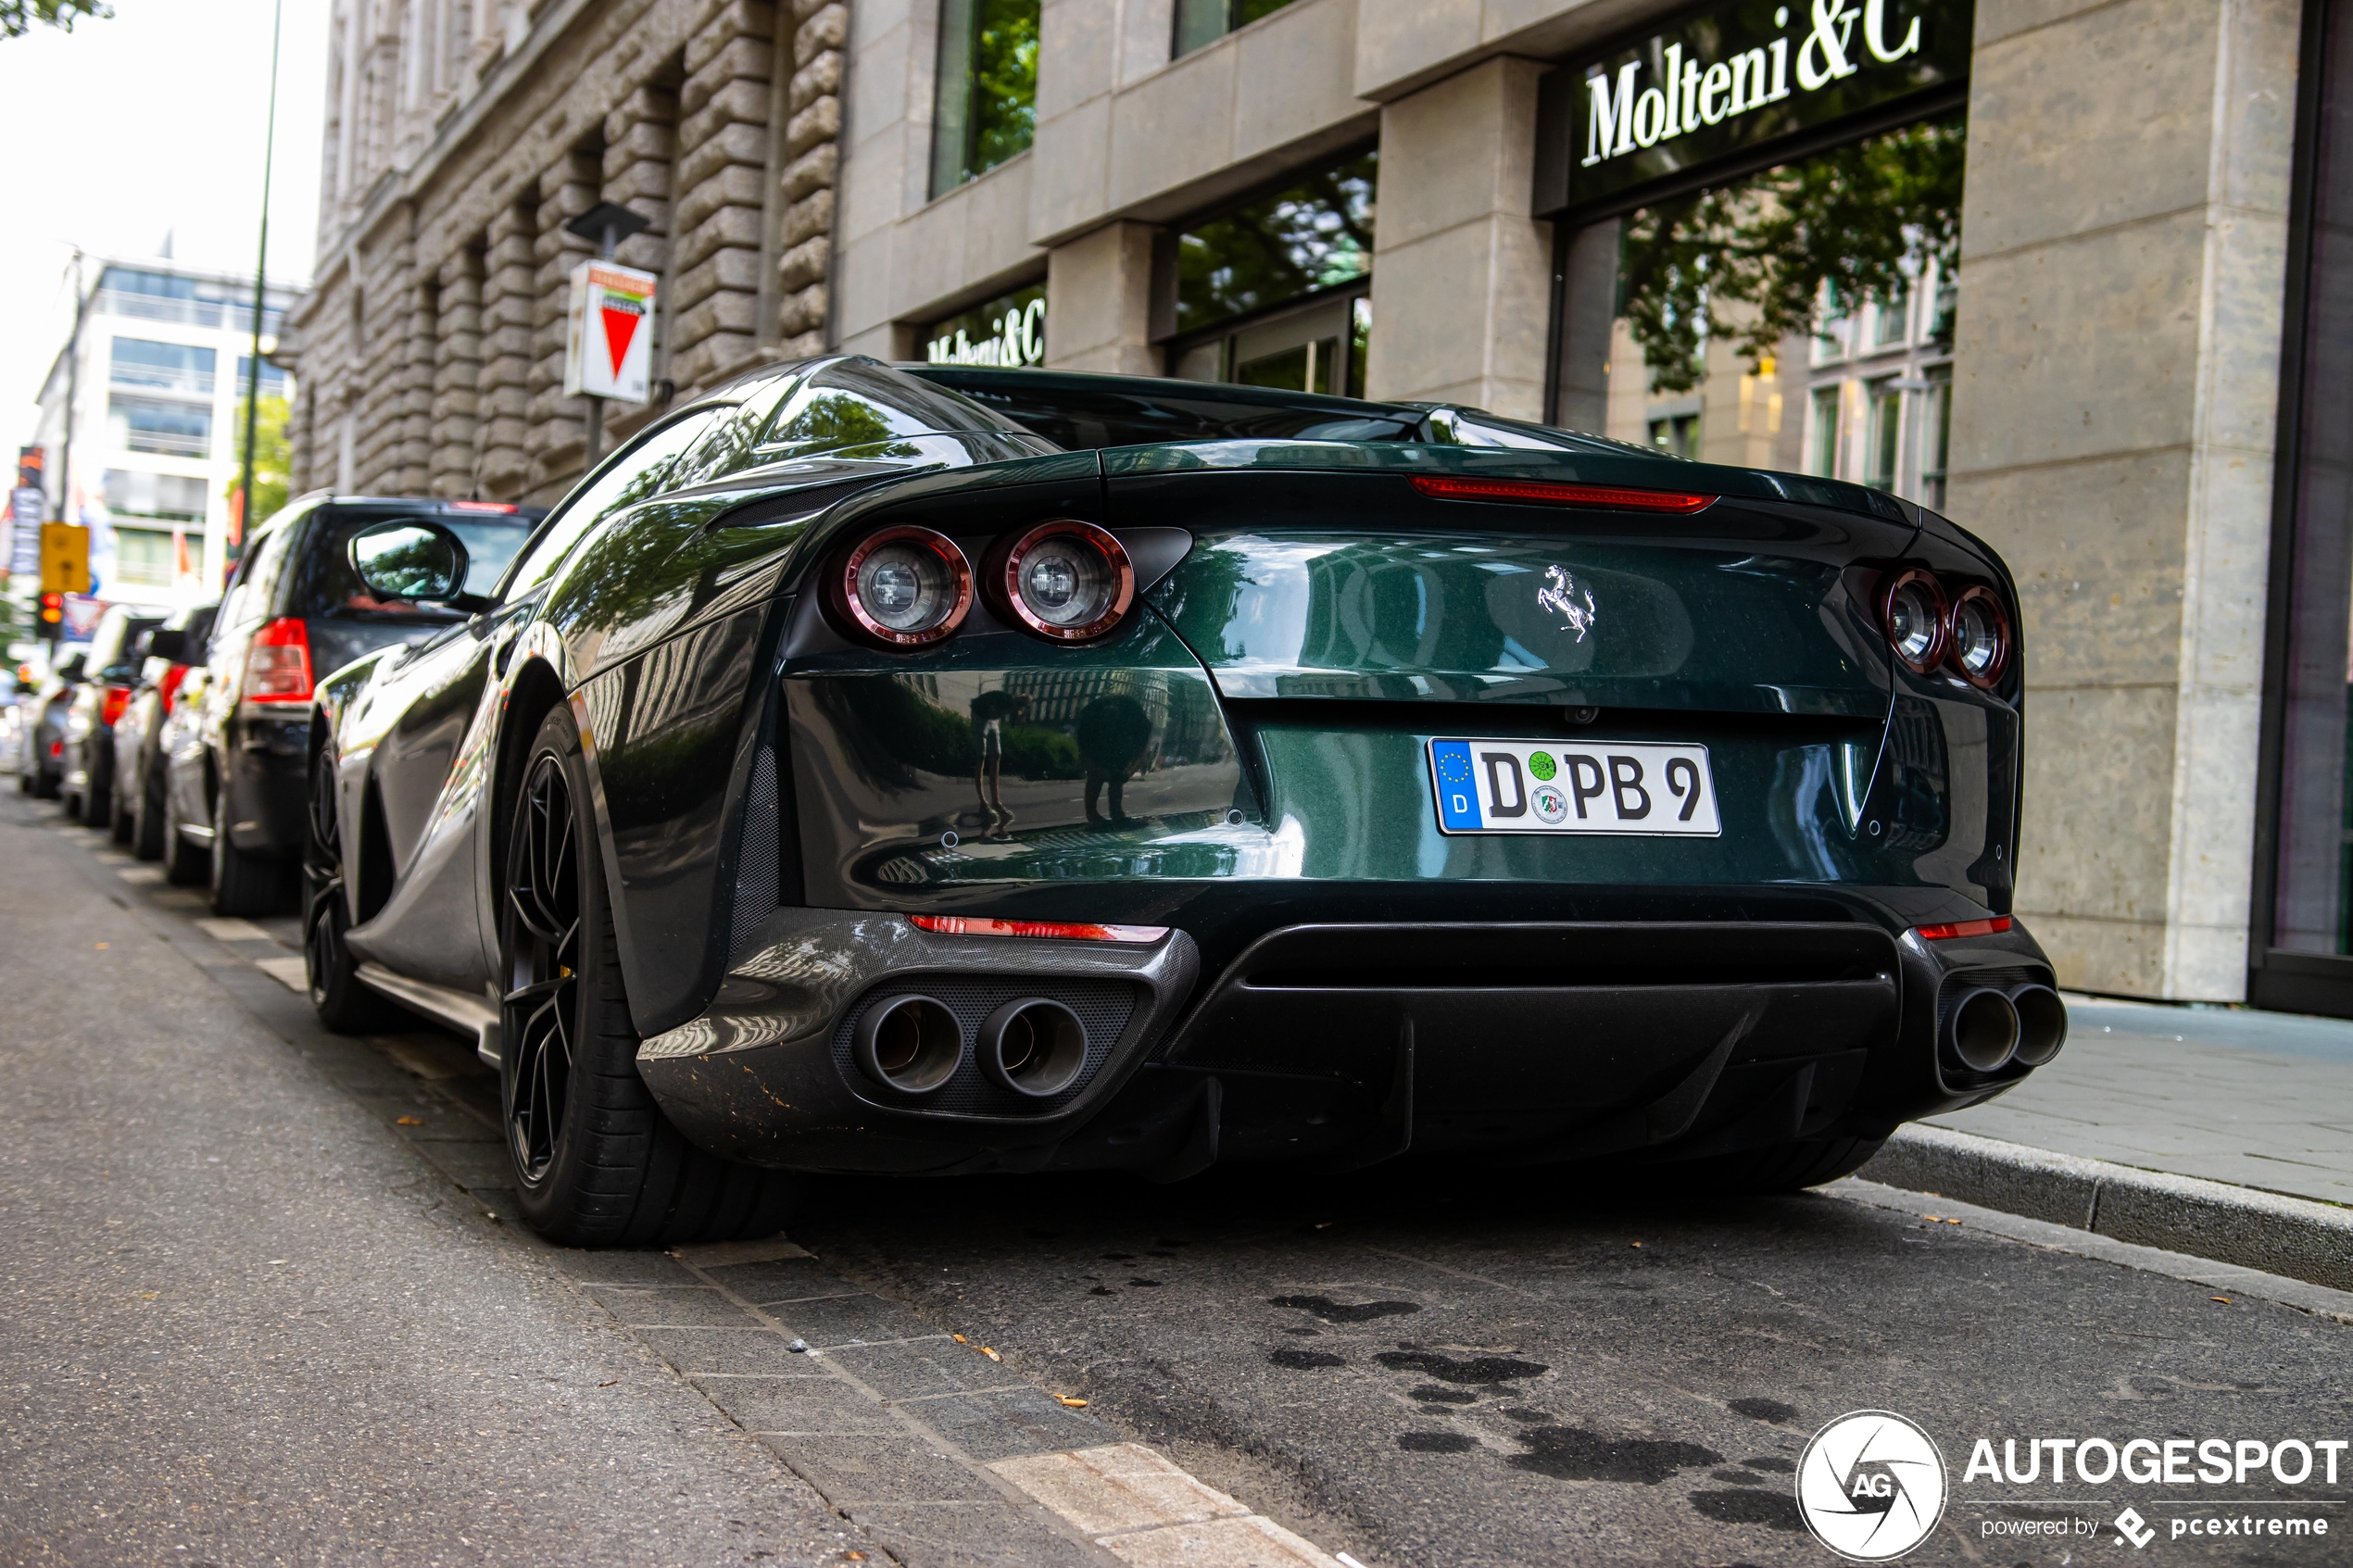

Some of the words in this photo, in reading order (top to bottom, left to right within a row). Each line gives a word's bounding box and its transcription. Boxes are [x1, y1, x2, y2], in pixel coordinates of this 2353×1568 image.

[1581, 0, 1920, 168] Molteni&C
[1453, 794, 1468, 814] D
[1480, 752, 1528, 818] D
[1564, 755, 1652, 821] PB
[1666, 757, 1702, 822] 9
